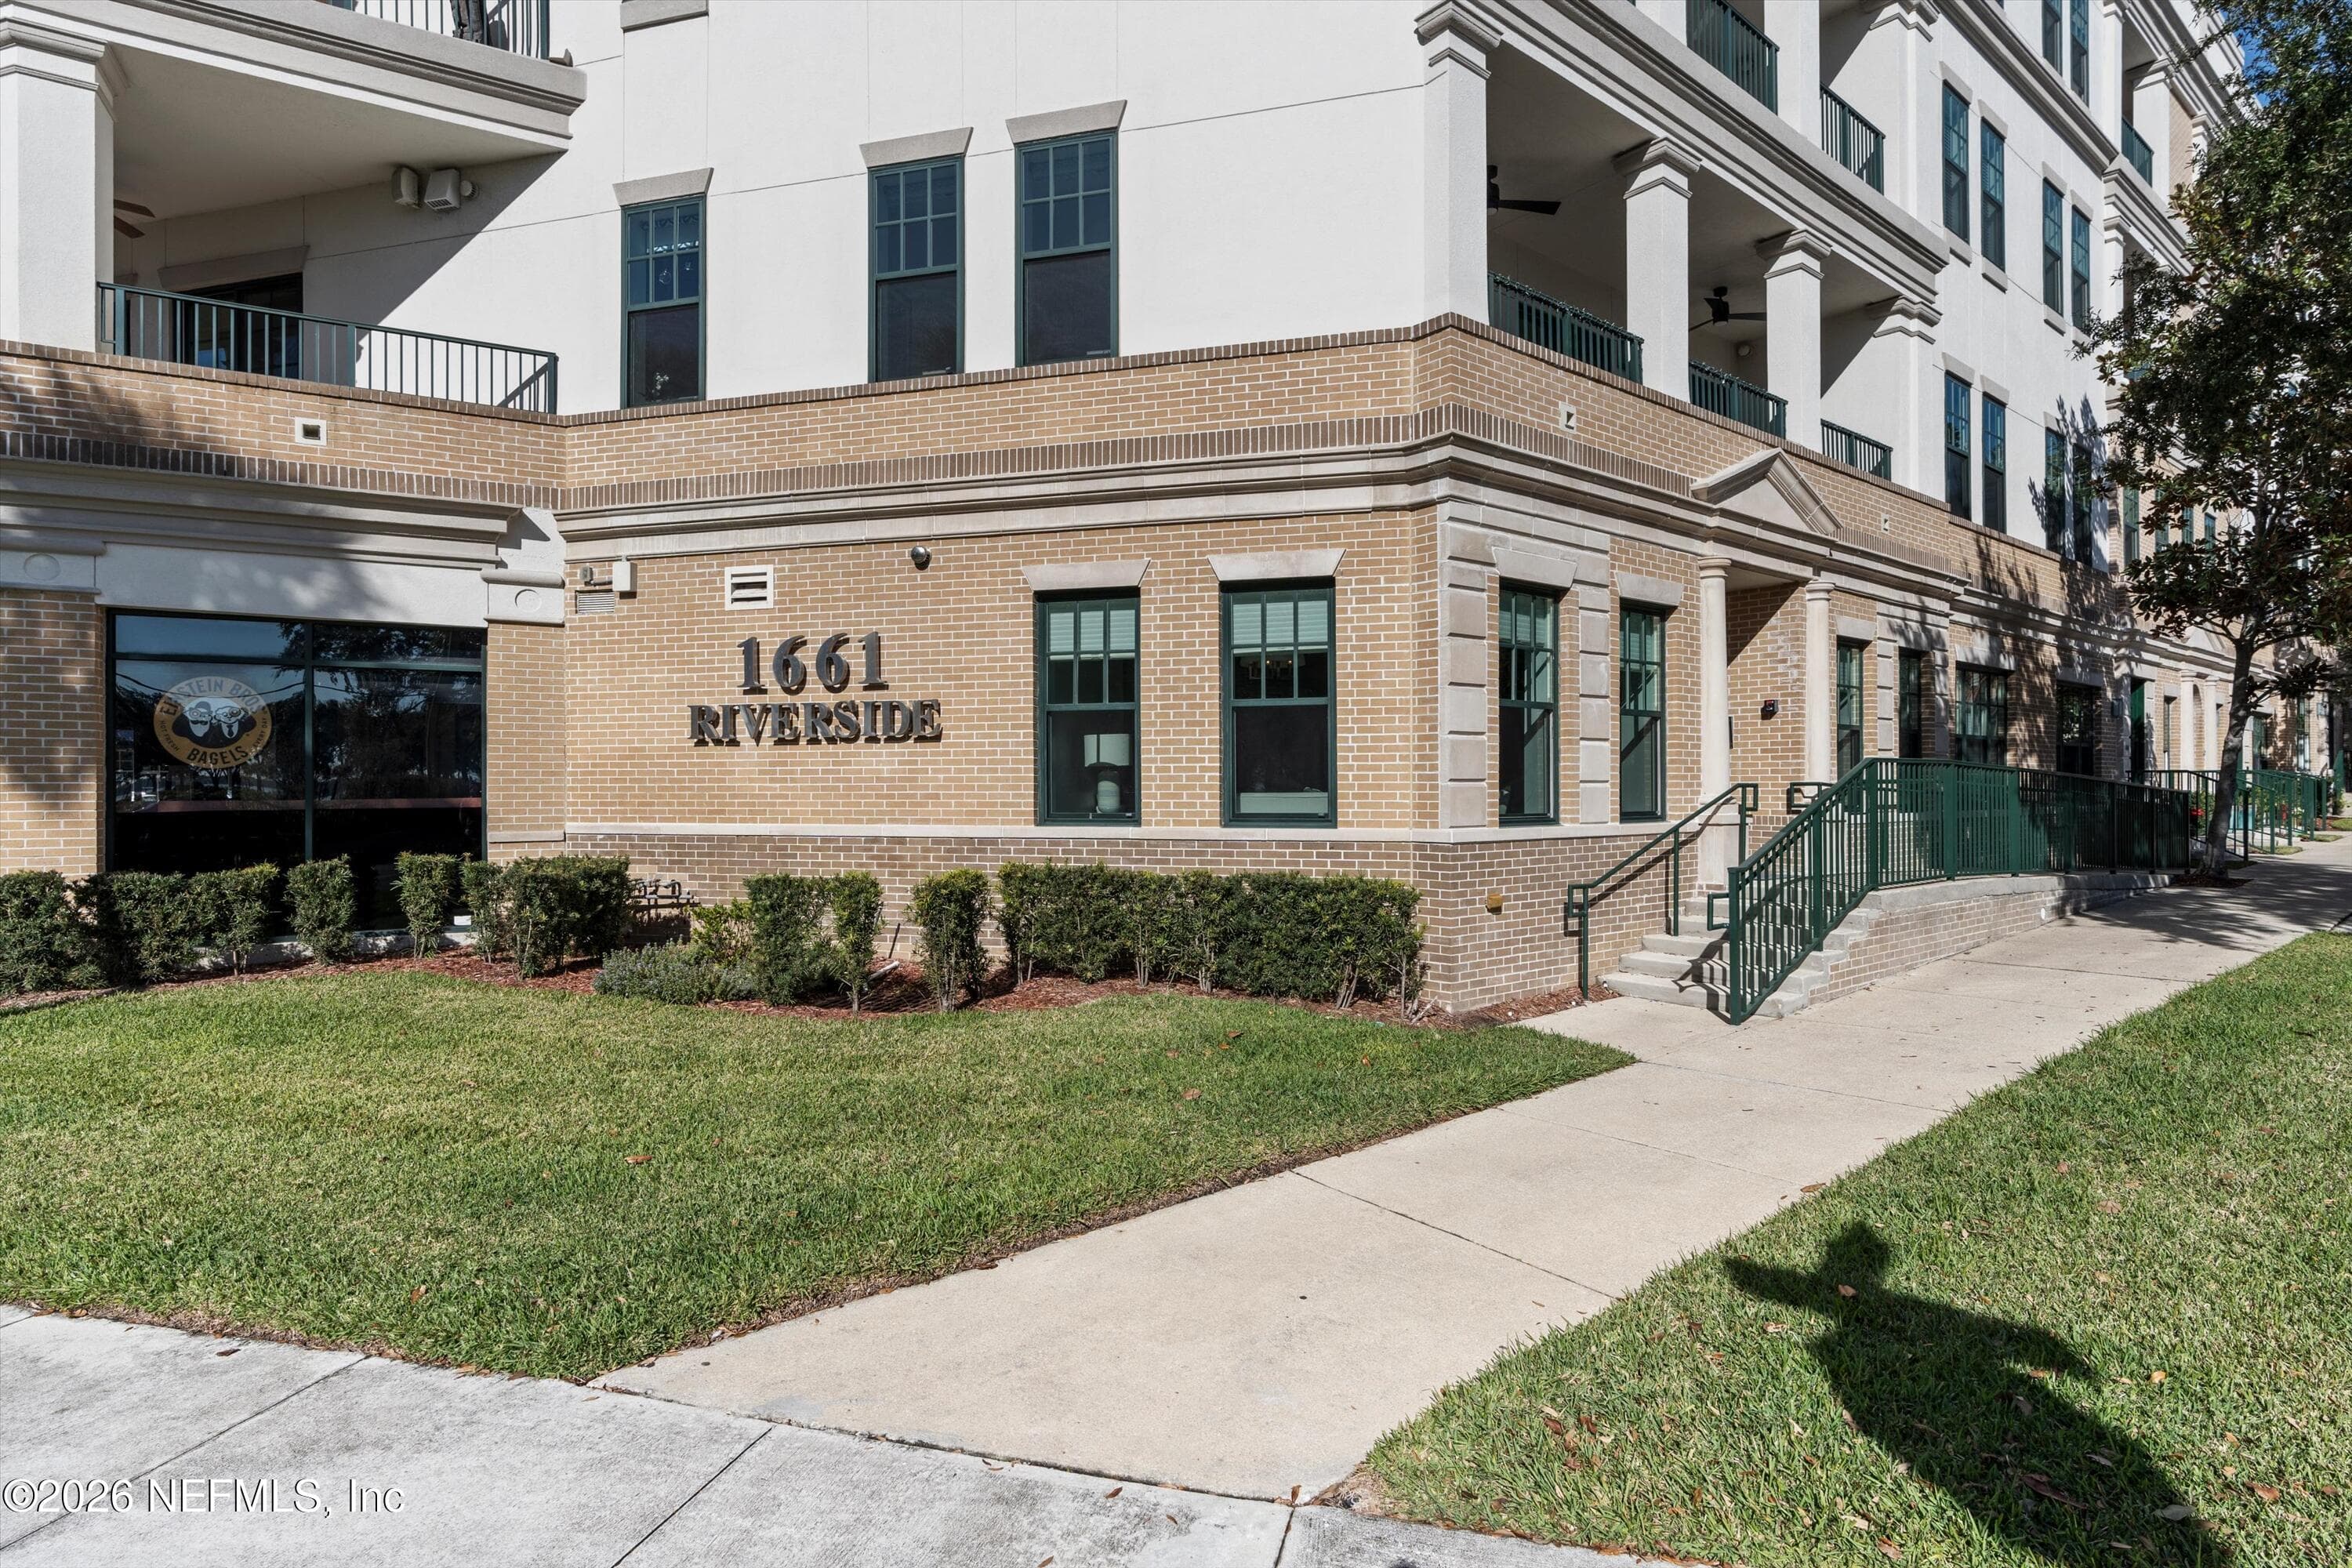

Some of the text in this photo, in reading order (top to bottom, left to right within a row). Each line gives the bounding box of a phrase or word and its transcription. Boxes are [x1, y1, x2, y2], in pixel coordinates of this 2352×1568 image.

[737, 631, 887, 693] 1661
[687, 699, 942, 744] RIVERSIDE
[164, 733, 181, 752] FRESH
[187, 746, 249, 765] BAGELS
